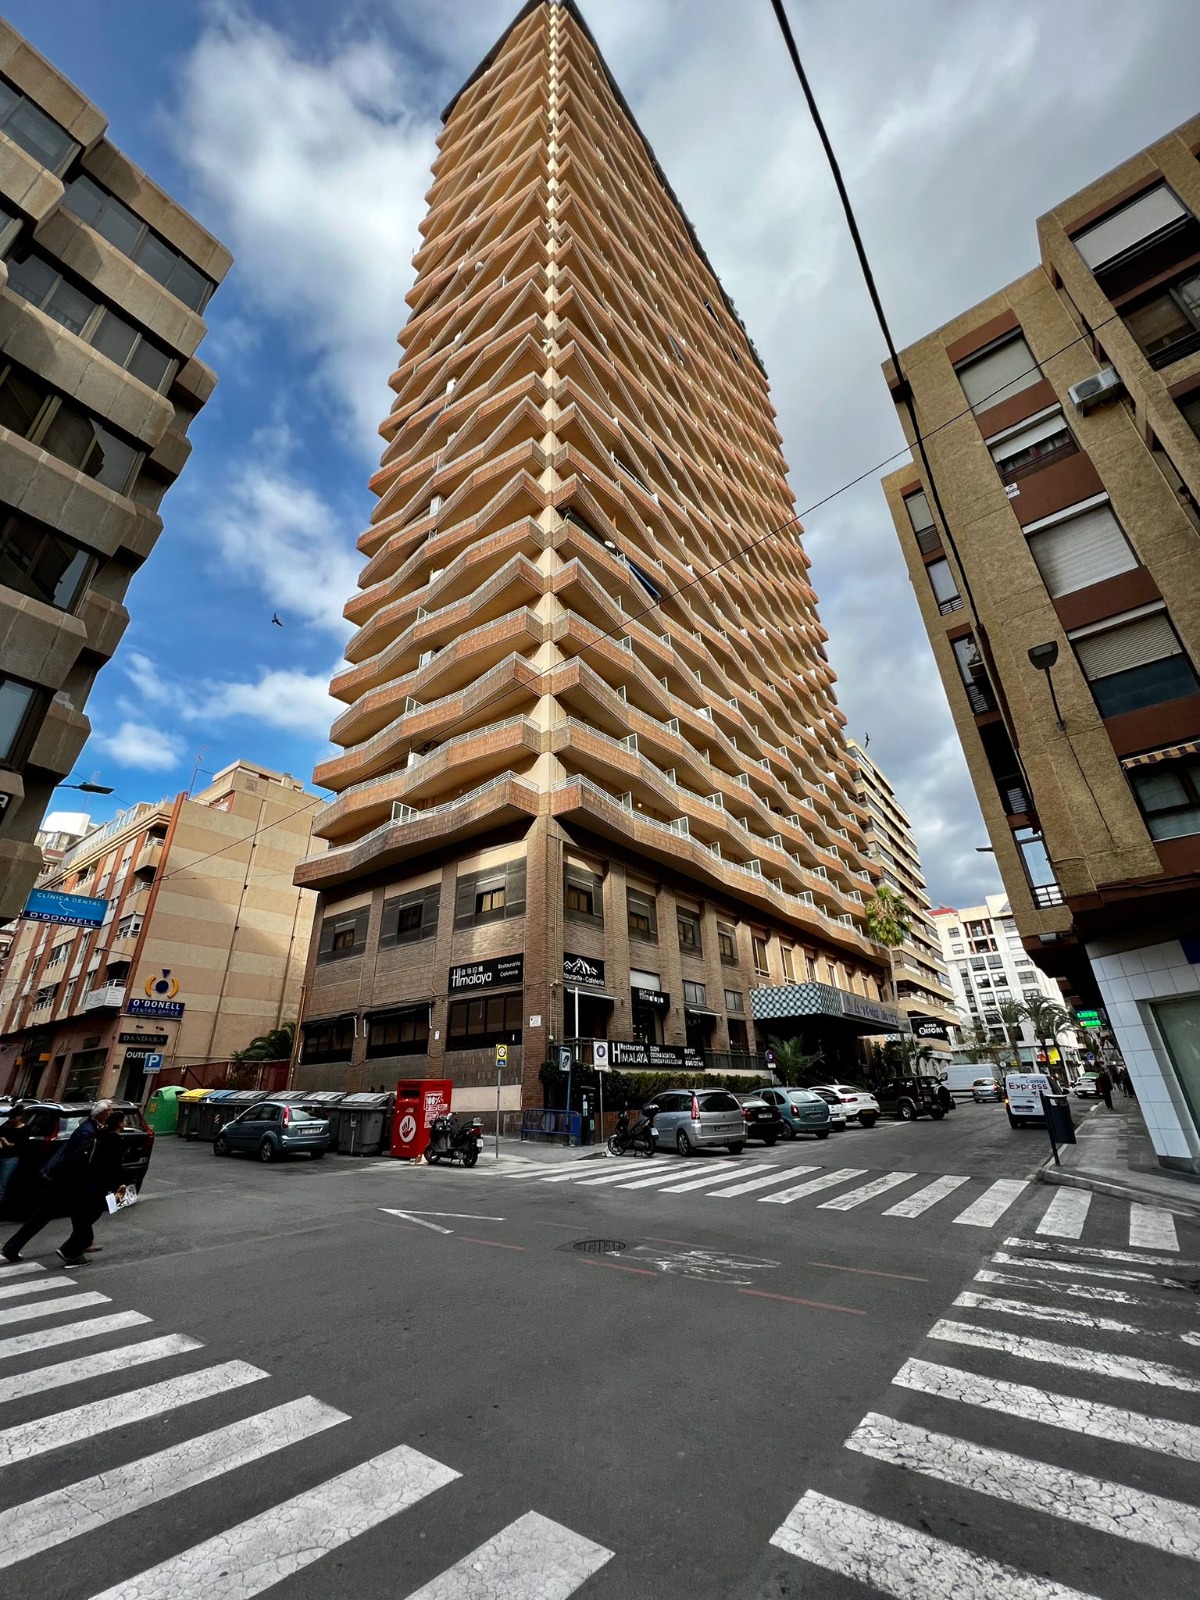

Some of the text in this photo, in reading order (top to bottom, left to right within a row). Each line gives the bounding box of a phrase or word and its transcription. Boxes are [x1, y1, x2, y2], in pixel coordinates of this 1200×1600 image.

[37, 892, 101, 906] CLÍNICA DENTAL
[30, 911, 96, 926] O'DONNELL
[133, 1000, 180, 1010] O'DONELL
[123, 1035, 164, 1043] DANDARA
[612, 1042, 648, 1063] HIMALAYA
[620, 1043, 644, 1051] Restaurante
[148, 1055, 160, 1067] P
[1009, 1083, 1048, 1091] Express
